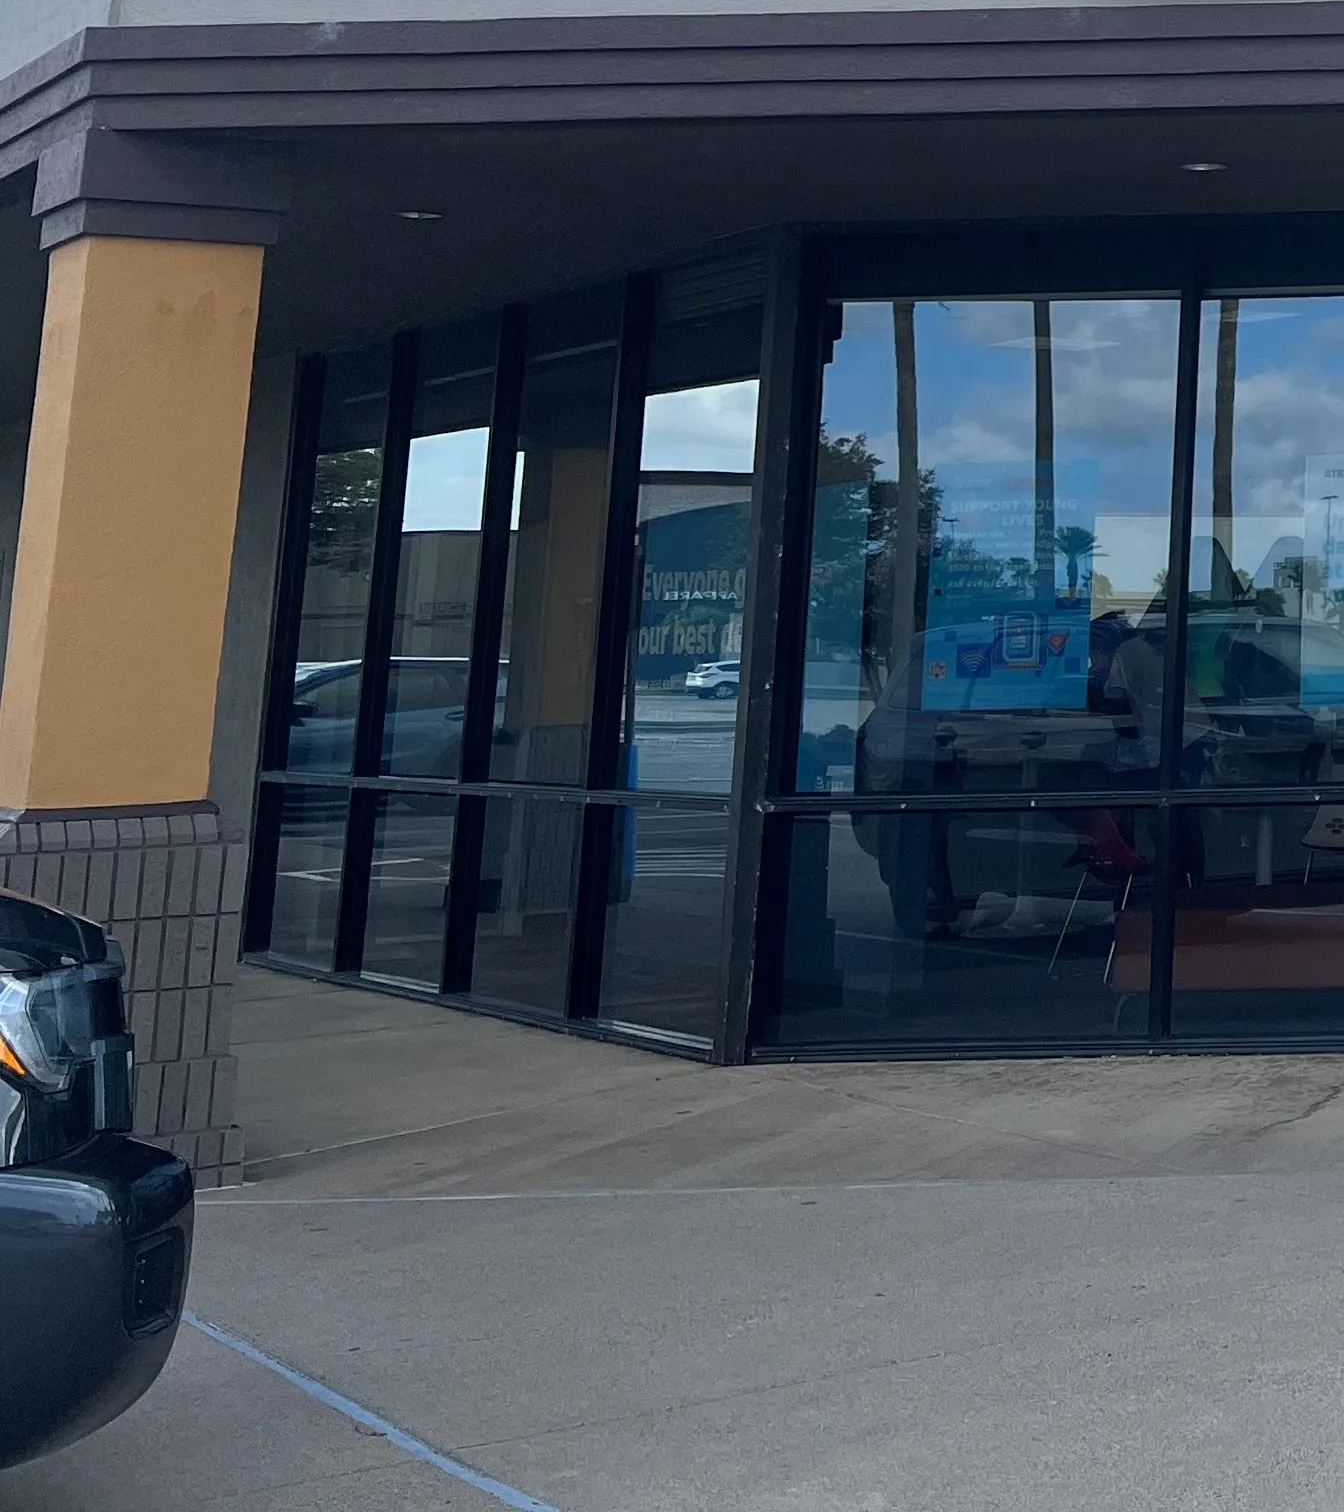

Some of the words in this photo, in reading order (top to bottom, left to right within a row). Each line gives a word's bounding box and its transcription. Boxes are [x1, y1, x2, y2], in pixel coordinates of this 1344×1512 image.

[951, 500, 1019, 513] SUPPORT
[1025, 499, 1077, 512] YOUNG
[1001, 513, 1045, 527] LIVES
[642, 564, 730, 610] Everyone
[639, 625, 671, 655] our
[672, 614, 717, 656] best
